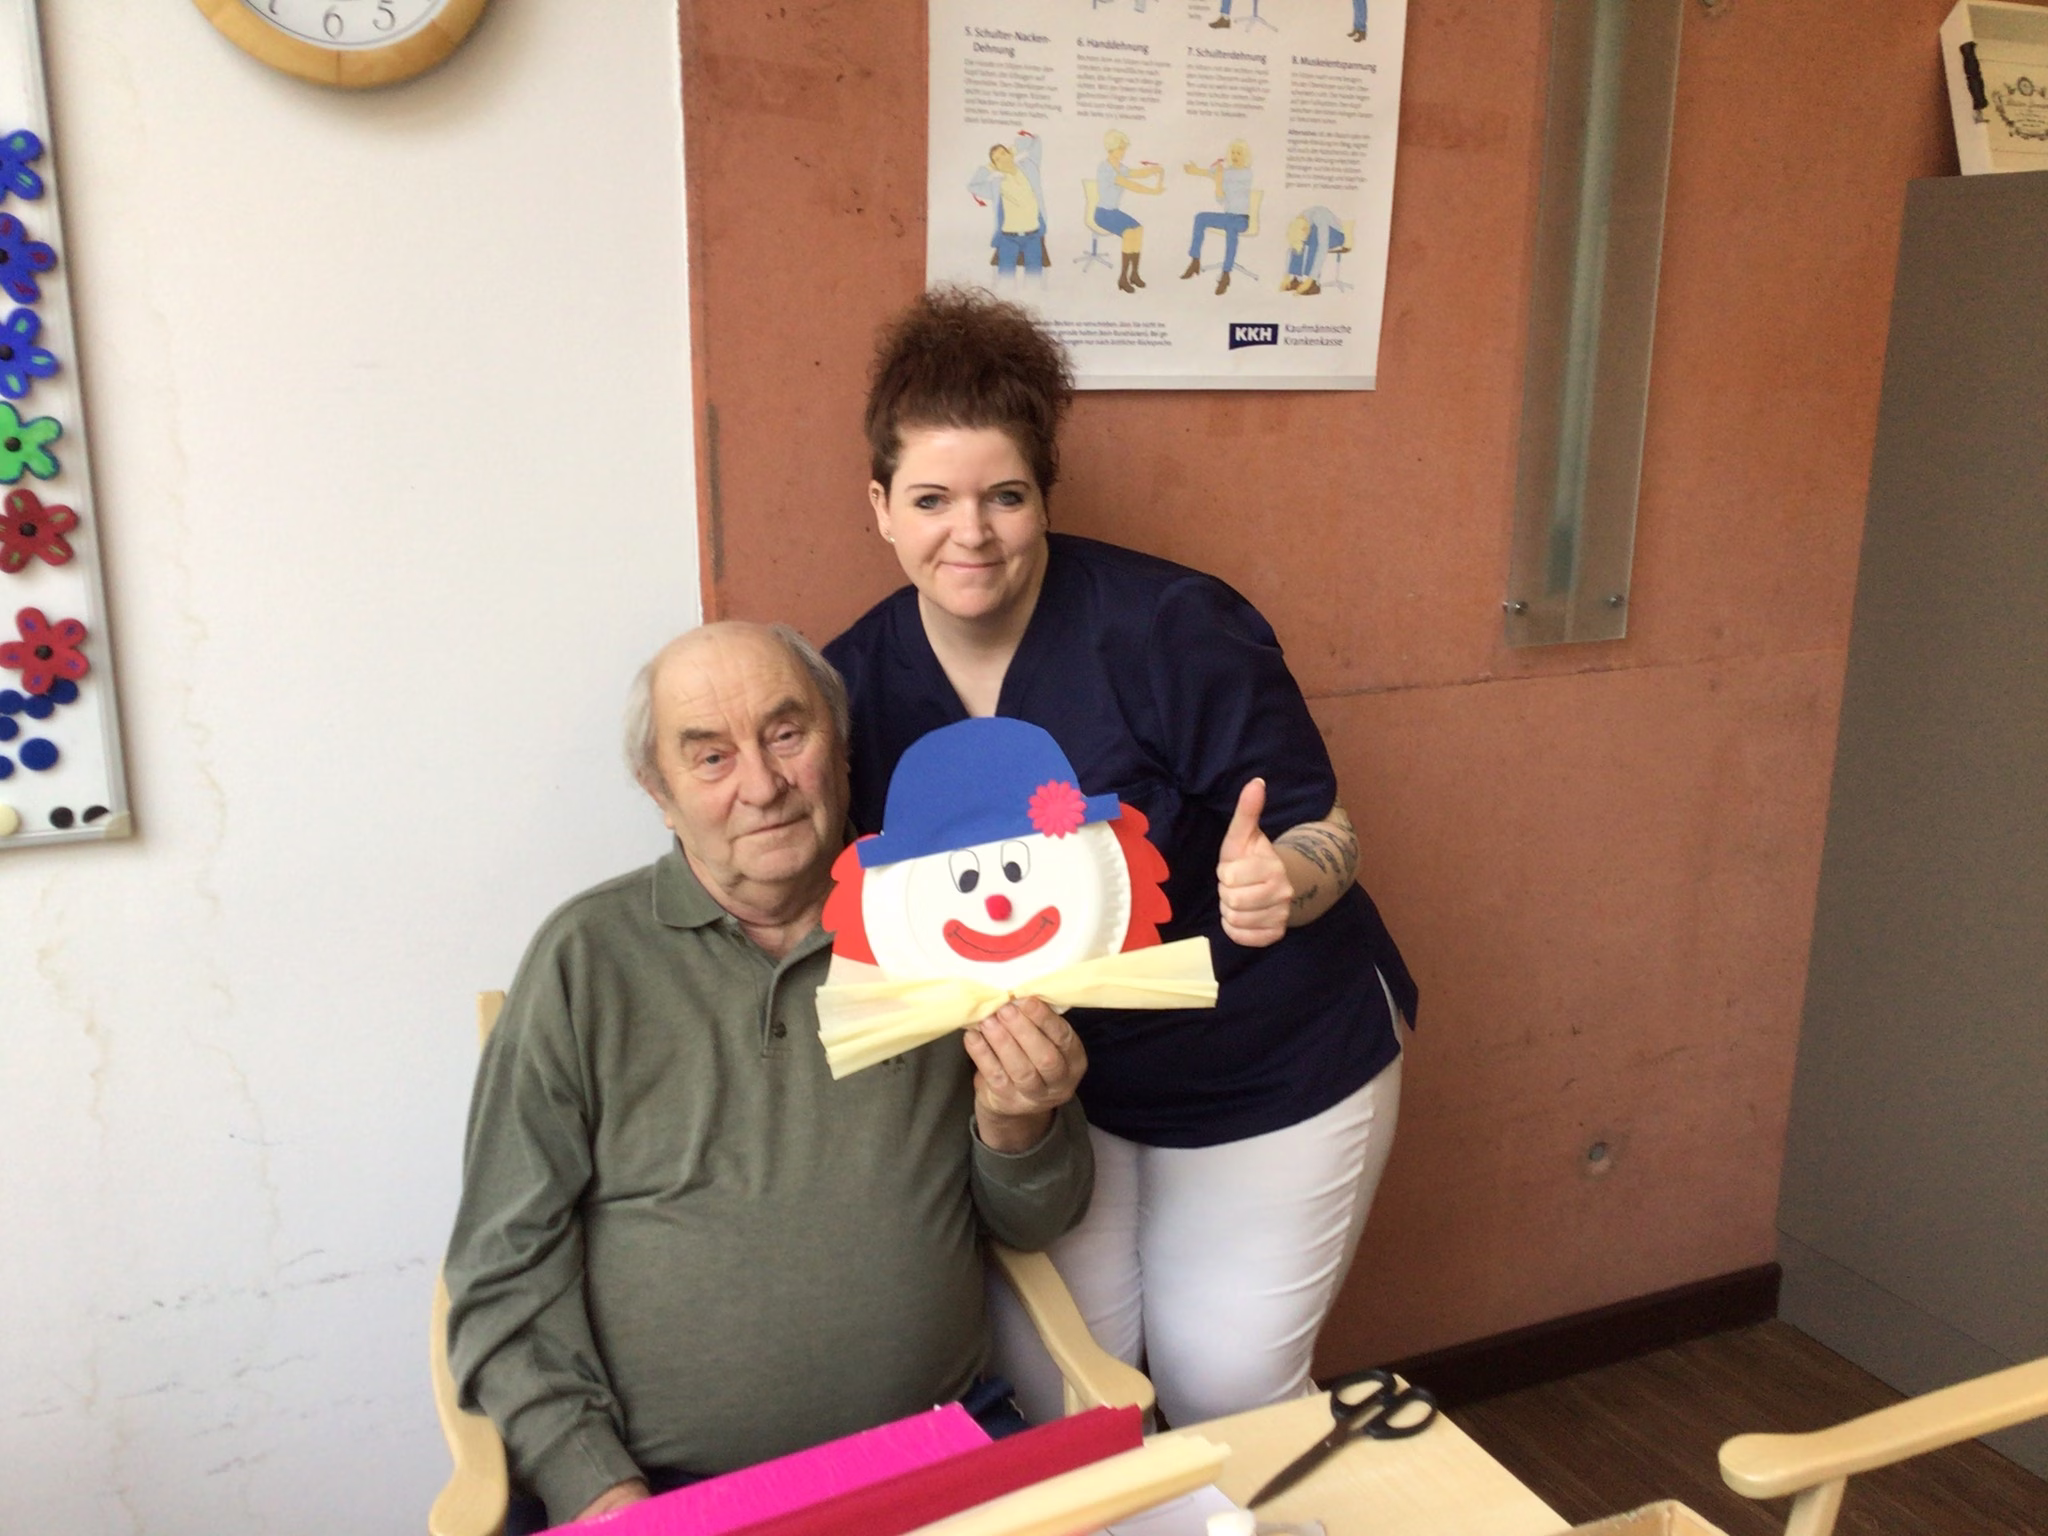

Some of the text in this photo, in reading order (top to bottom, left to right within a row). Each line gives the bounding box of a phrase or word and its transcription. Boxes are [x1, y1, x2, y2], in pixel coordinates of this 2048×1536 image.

[323, 6, 343, 39] 6
[373, 0, 395, 31] 5
[973, 41, 1016, 58] Dehnung
[1086, 38, 1149, 55] Handdehnung
[1195, 47, 1267, 65] Schulterdehnung
[1300, 55, 1377, 74] Muskelentspannung
[1235, 326, 1273, 342] KKH
[1285, 323, 1352, 334] Kaufmännische
[1284, 336, 1344, 347] Krankenkasse
